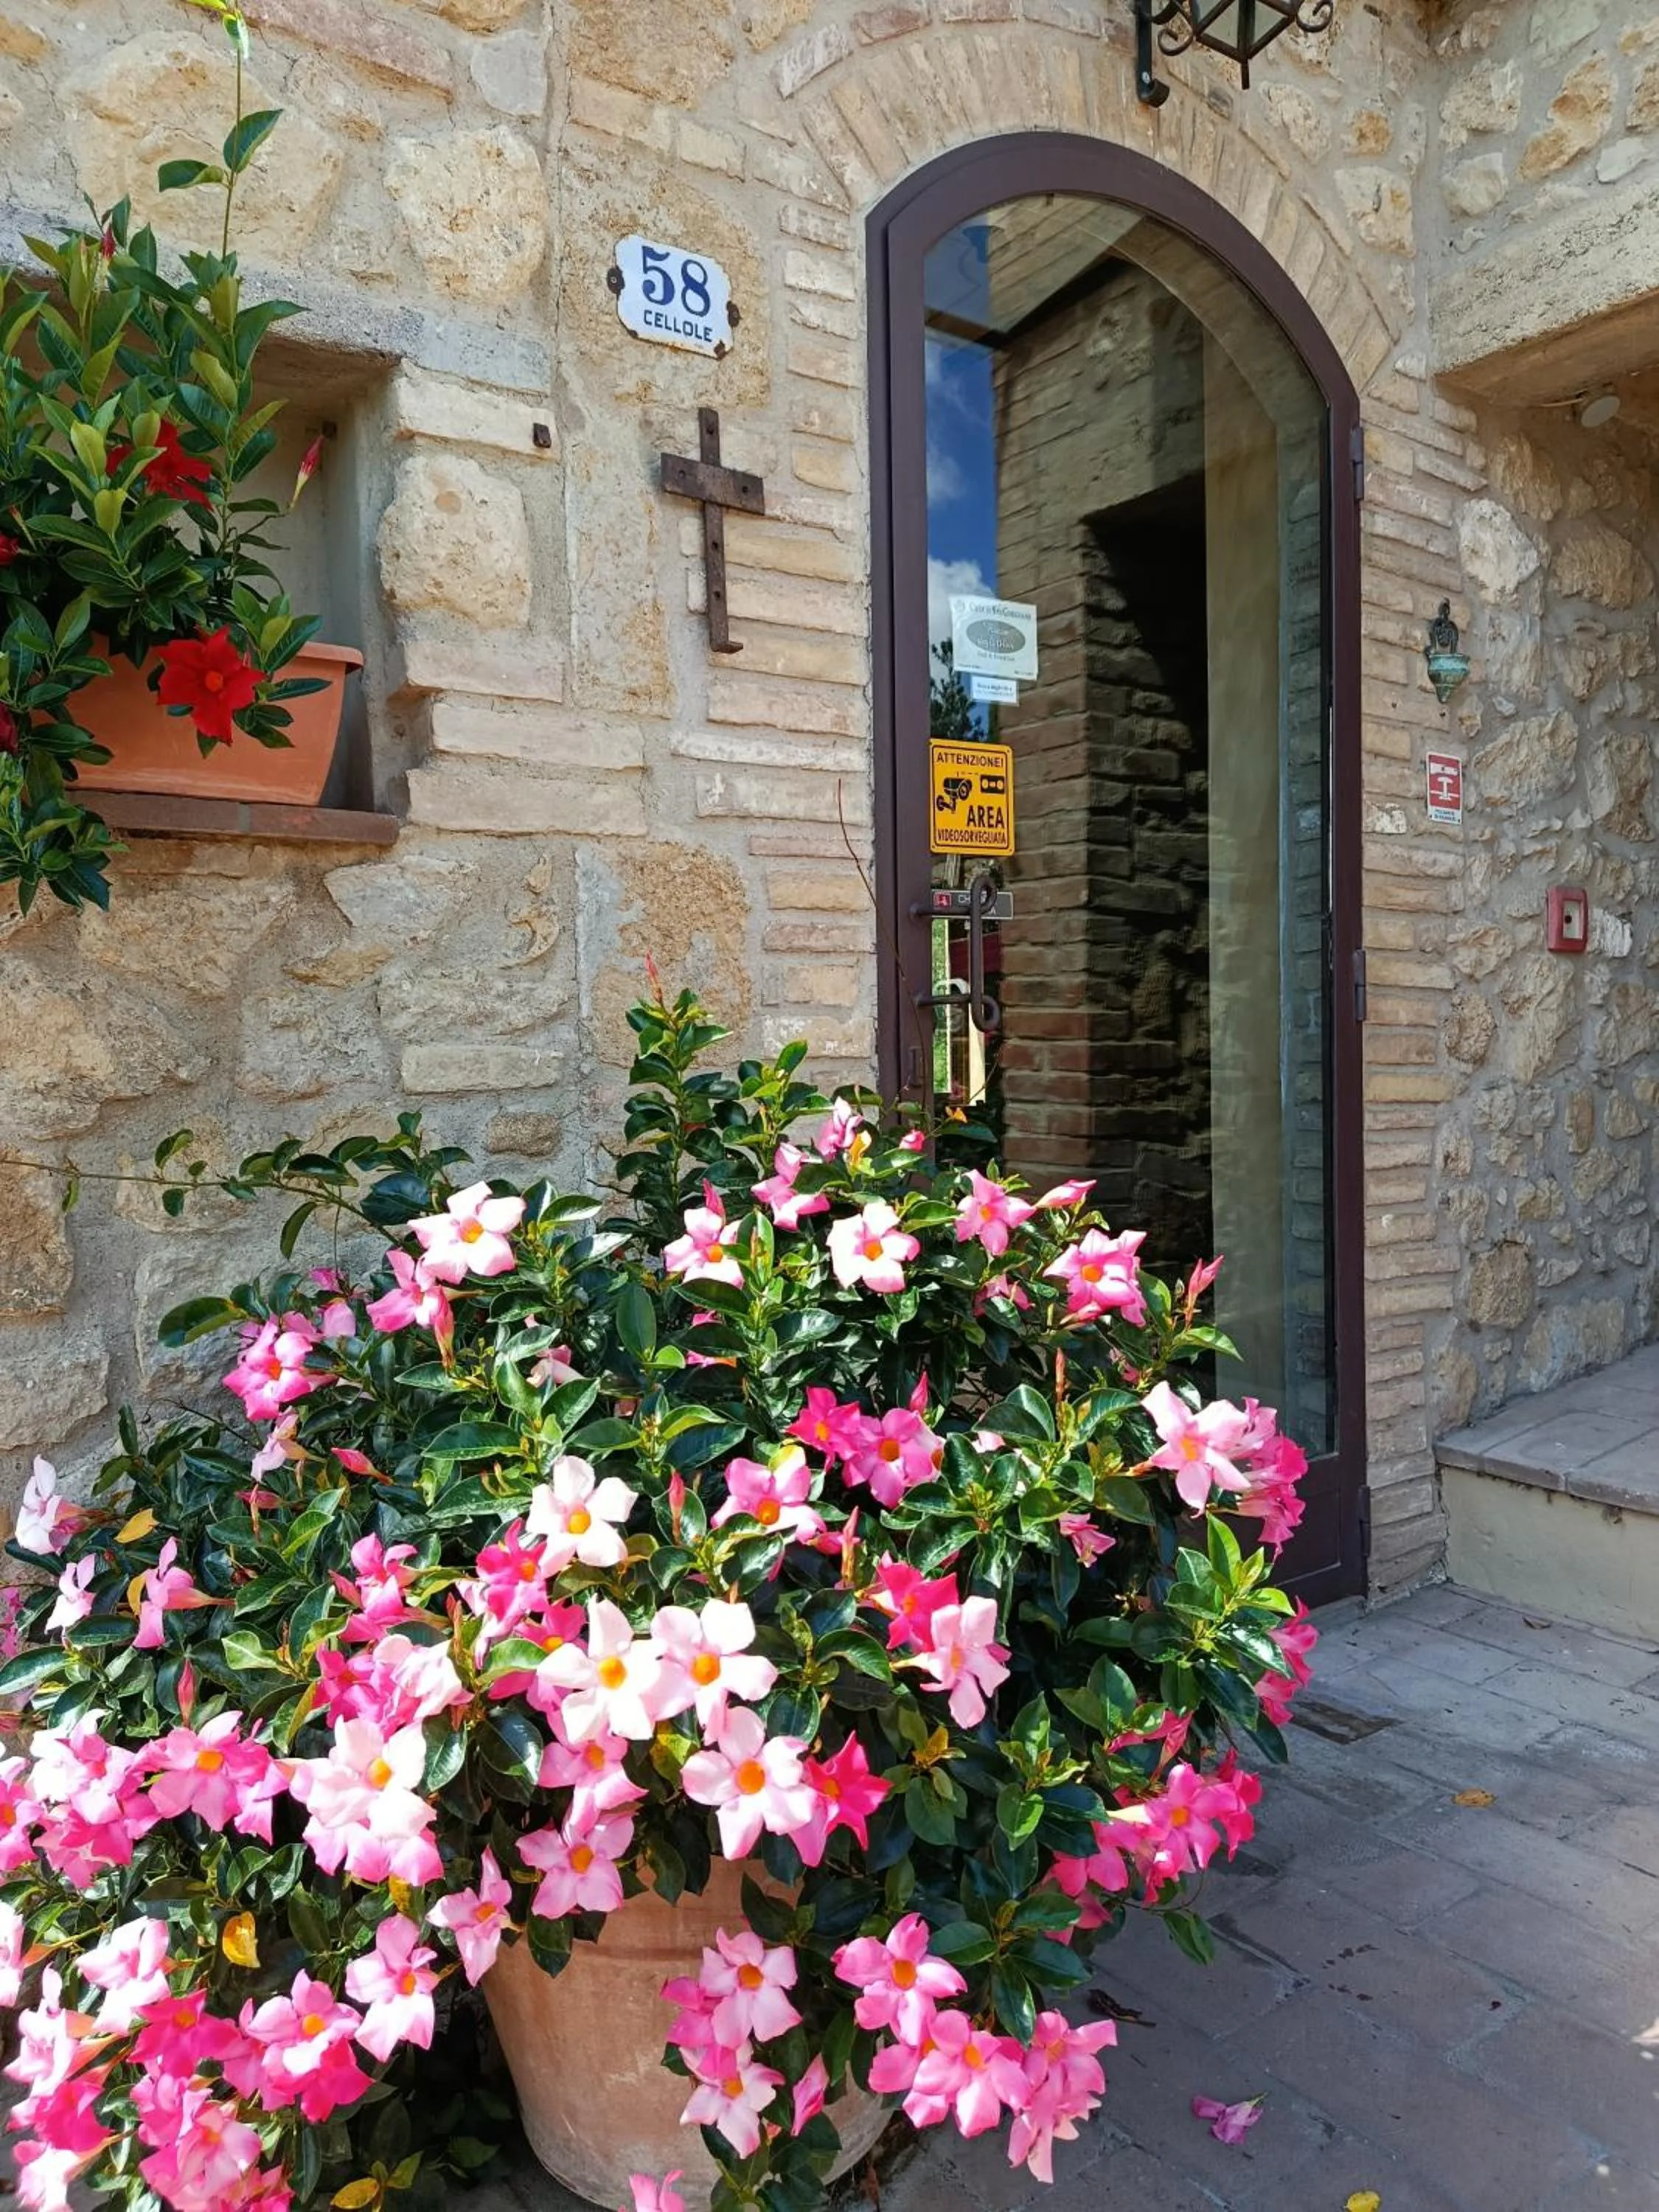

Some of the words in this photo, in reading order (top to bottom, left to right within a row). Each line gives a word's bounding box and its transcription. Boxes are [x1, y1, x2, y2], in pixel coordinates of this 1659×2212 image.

[641, 246, 711, 317] 58
[644, 309, 713, 343] CELLOLE
[967, 804, 1005, 829] AREA
